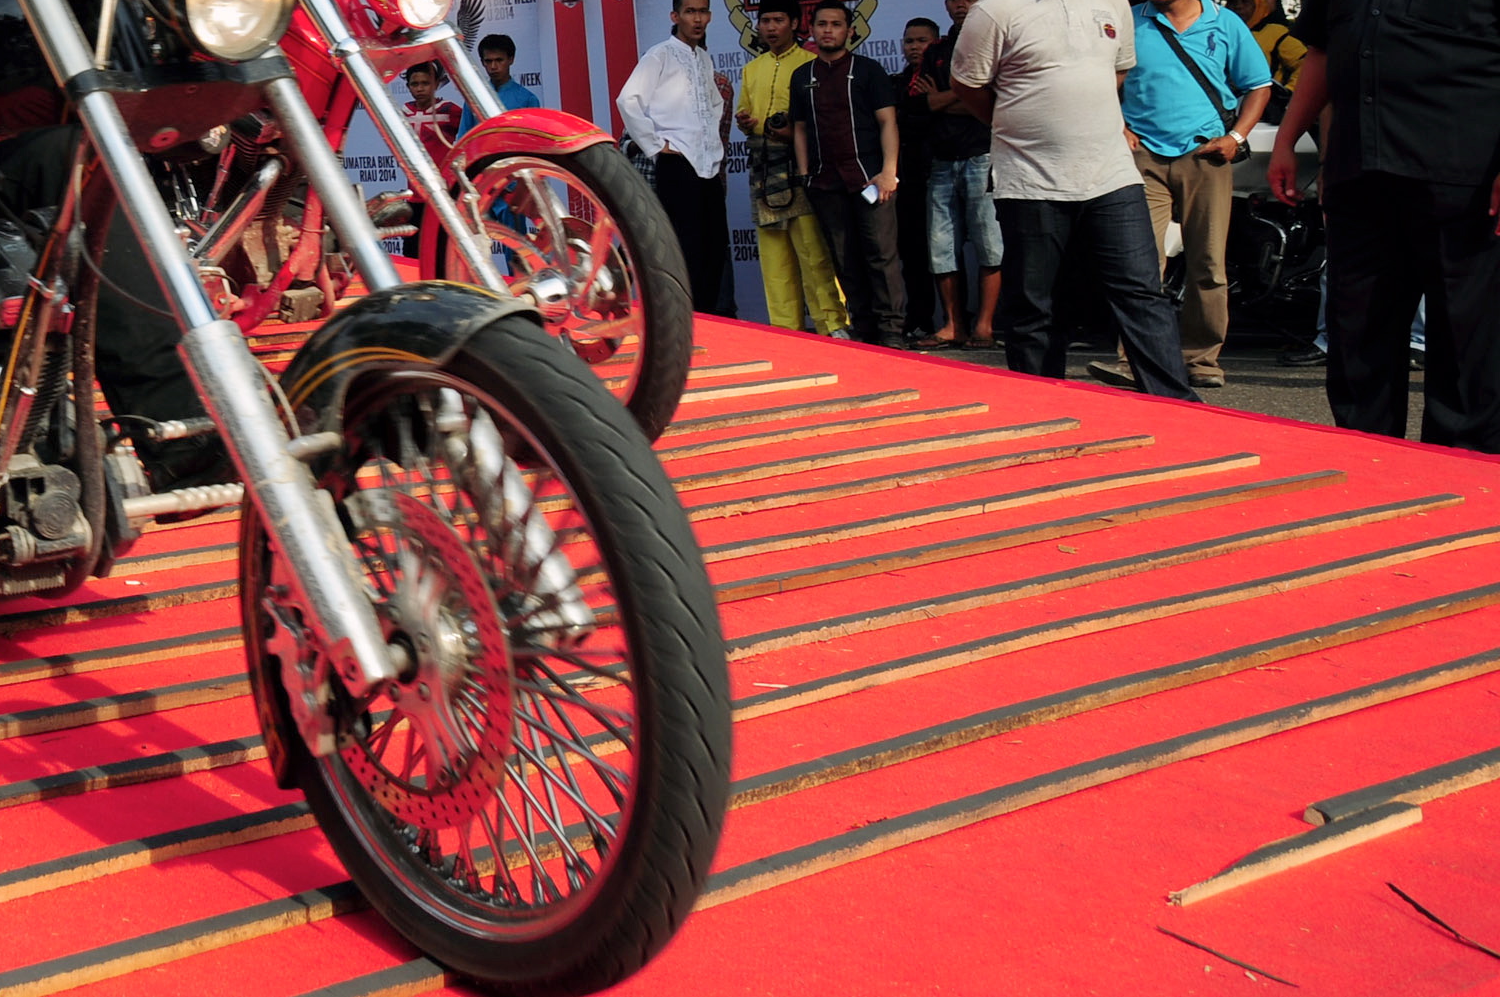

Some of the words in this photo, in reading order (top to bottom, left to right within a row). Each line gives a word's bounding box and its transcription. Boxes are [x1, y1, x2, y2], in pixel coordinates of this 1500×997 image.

[495, 5, 514, 21] 2014
[718, 51, 742, 68] BIKE
[378, 155, 395, 169] BIKE
[360, 169, 378, 183] RIAU
[379, 169, 397, 183] 2014
[732, 229, 756, 245] BIKE
[733, 246, 760, 262] 2014
